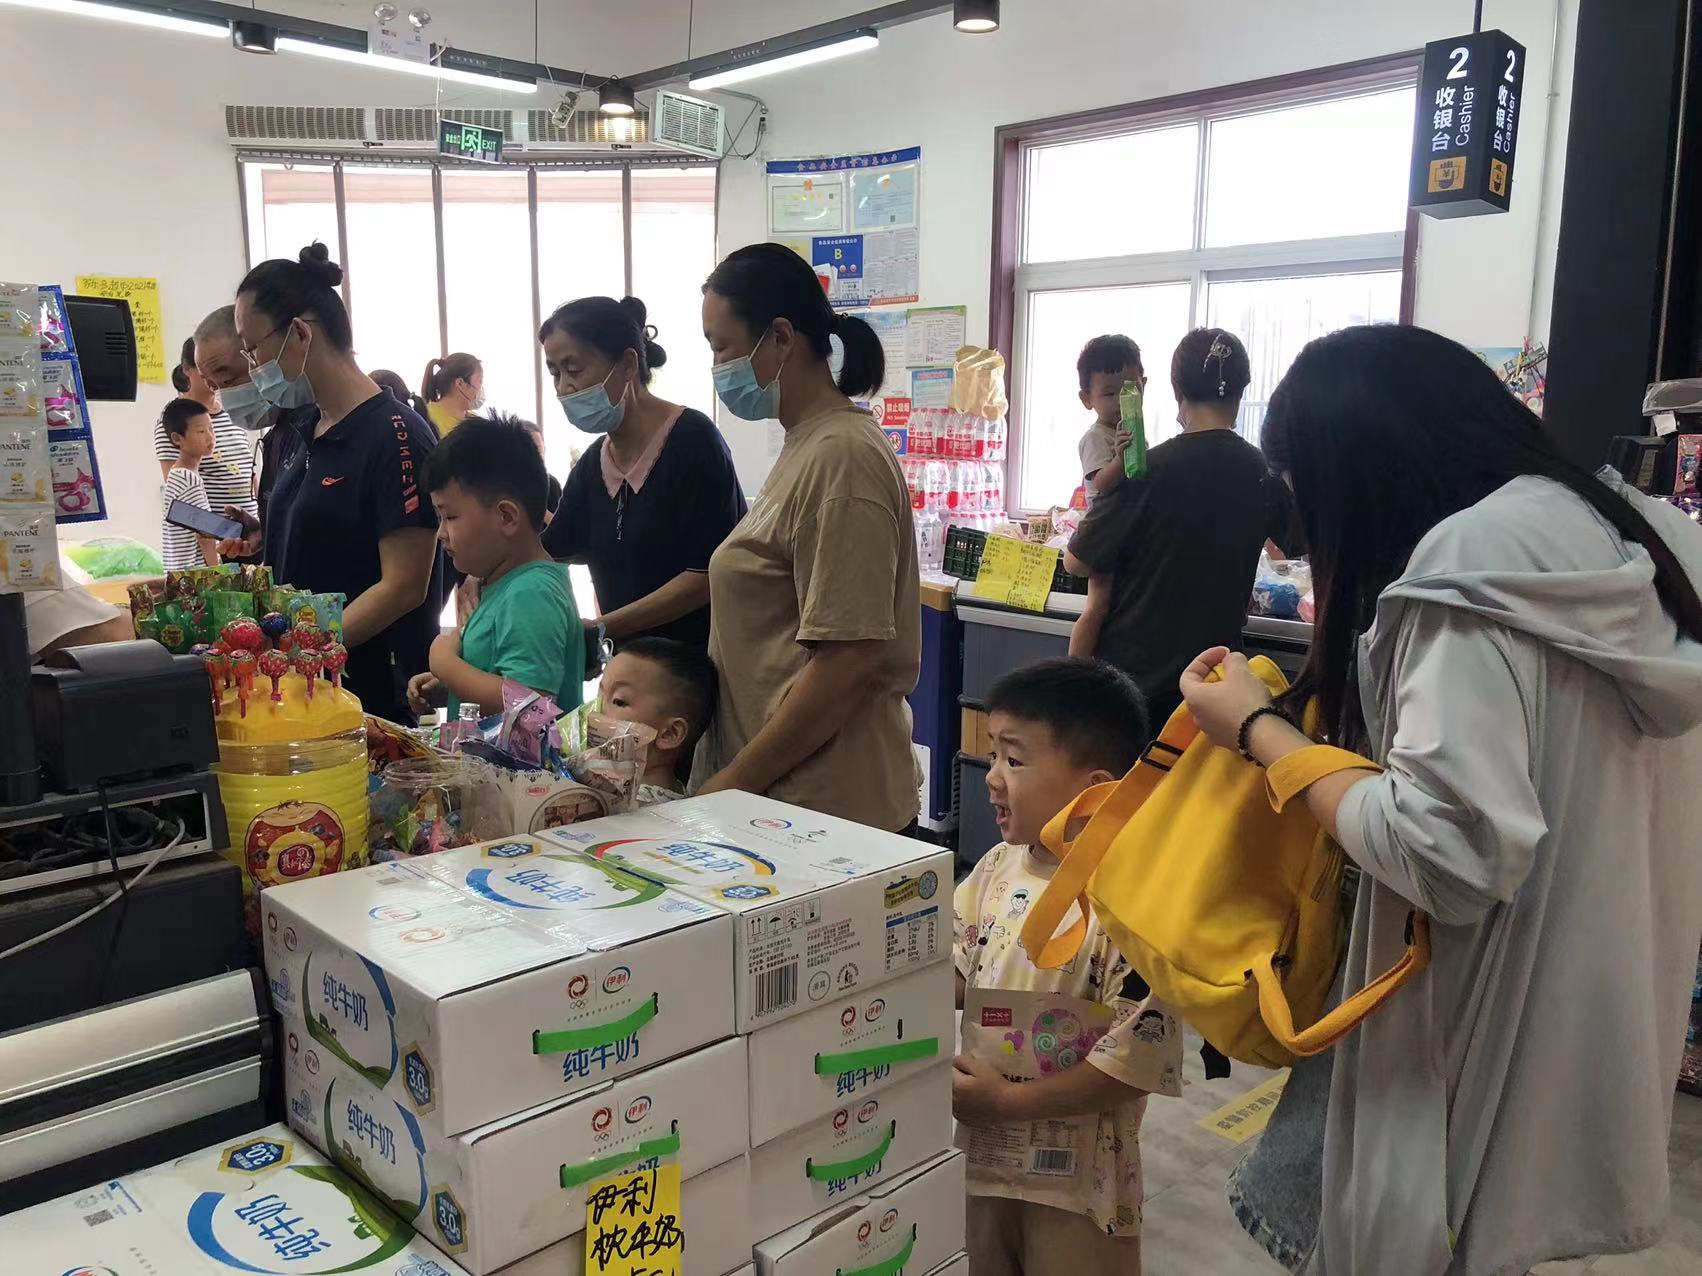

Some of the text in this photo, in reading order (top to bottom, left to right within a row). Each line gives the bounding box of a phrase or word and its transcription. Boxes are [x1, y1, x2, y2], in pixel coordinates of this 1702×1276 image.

[1446, 47, 1469, 80] 2
[1504, 49, 1515, 83] 2
[1431, 86, 1456, 152] 收银台
[1455, 85, 1475, 146] Cashier
[1493, 84, 1508, 151] 收银台
[1503, 92, 1516, 153] Cashier
[482, 140, 497, 151] EXIT
[834, 248, 843, 260] B
[3, 529, 40, 537] PANTENE
[657, 843, 745, 875] 纯牛奶
[505, 868, 597, 903] 纯牛奶
[606, 972, 627, 988] 伊利
[323, 970, 369, 1032] 纯牛奶
[563, 1030, 639, 1083] 纯牛奶
[628, 1101, 648, 1118] 伊利
[348, 1099, 396, 1166] 纯牛奶
[245, 1143, 275, 1166] 3.0g
[233, 1193, 332, 1261] 纯牛奶
